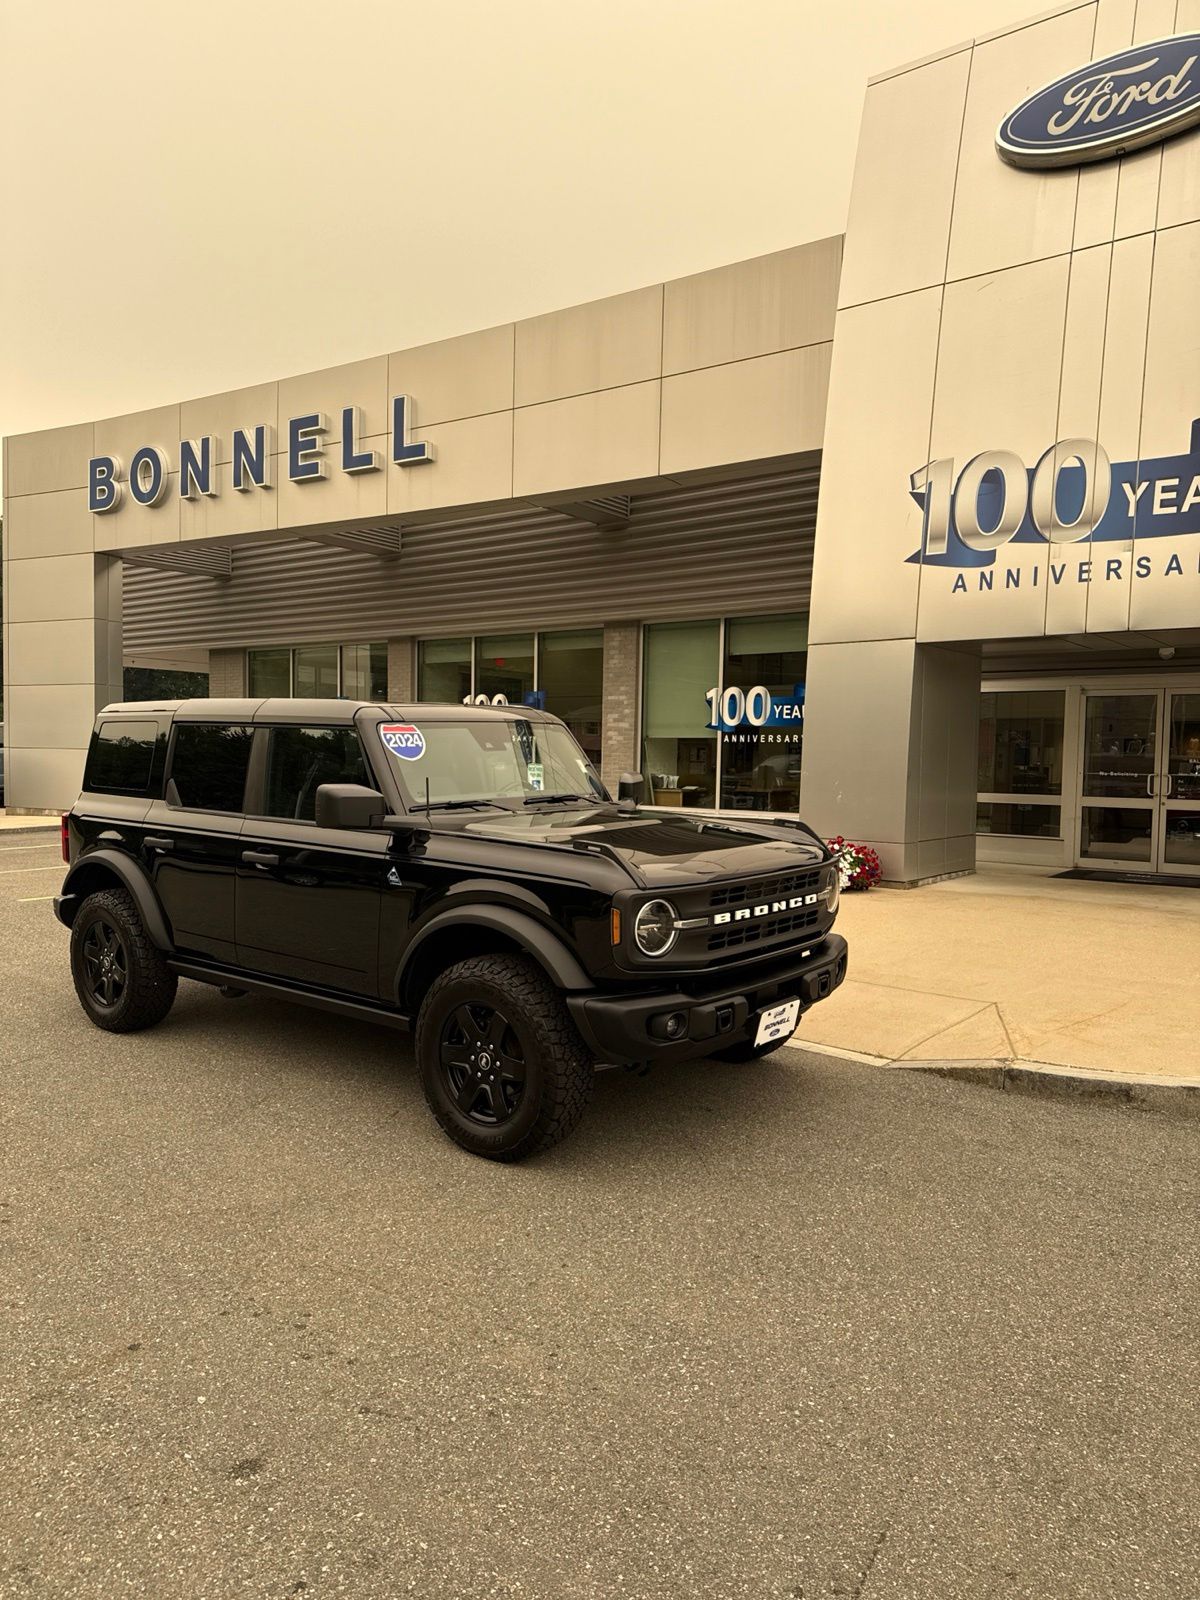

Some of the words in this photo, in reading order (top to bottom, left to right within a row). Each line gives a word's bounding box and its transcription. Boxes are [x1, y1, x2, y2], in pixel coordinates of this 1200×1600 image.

[1047, 55, 1198, 136] Ford
[88, 394, 434, 514] BONNELL
[910, 437, 1112, 556] 100
[952, 553, 1200, 594] ANNIVERSA
[706, 686, 771, 726] 100
[388, 732, 423, 748] 2024
[713, 893, 818, 925] BRONCO
